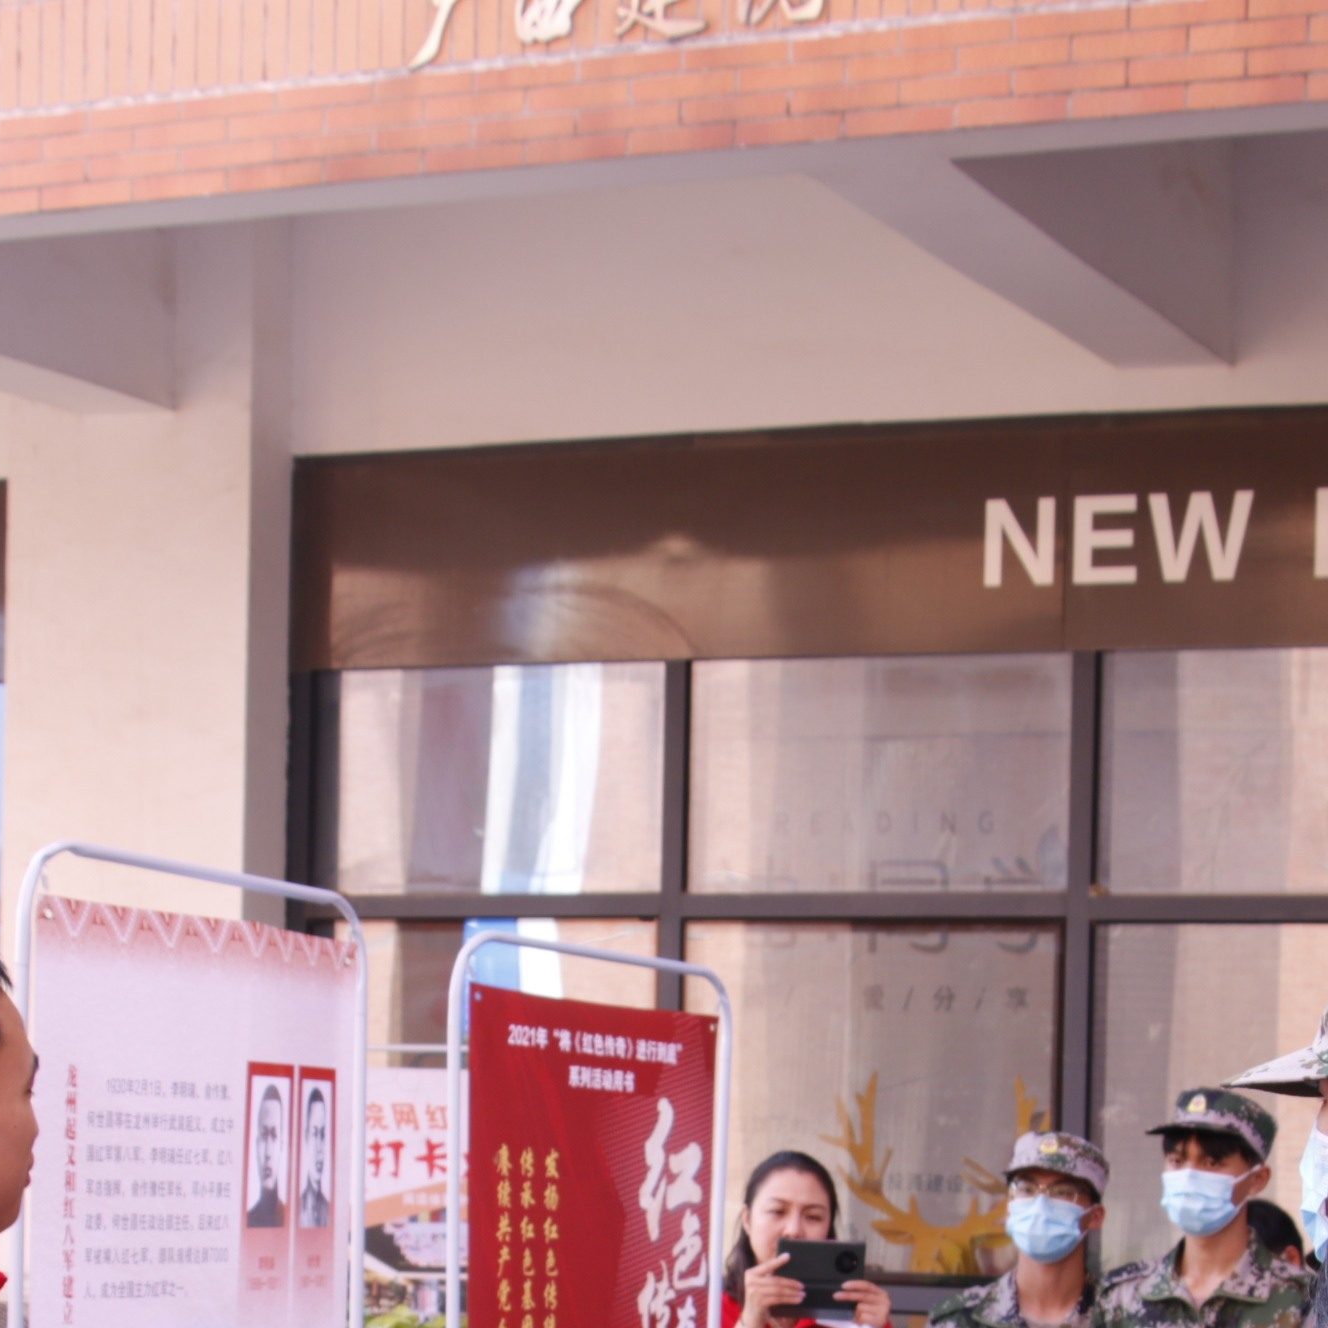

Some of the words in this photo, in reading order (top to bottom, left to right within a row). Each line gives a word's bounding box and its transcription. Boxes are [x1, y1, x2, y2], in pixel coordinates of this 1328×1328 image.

[983, 490, 1255, 588] NEW
[567, 1064, 637, 1094] 系列活动用书
[368, 1136, 469, 1179] 打卡
